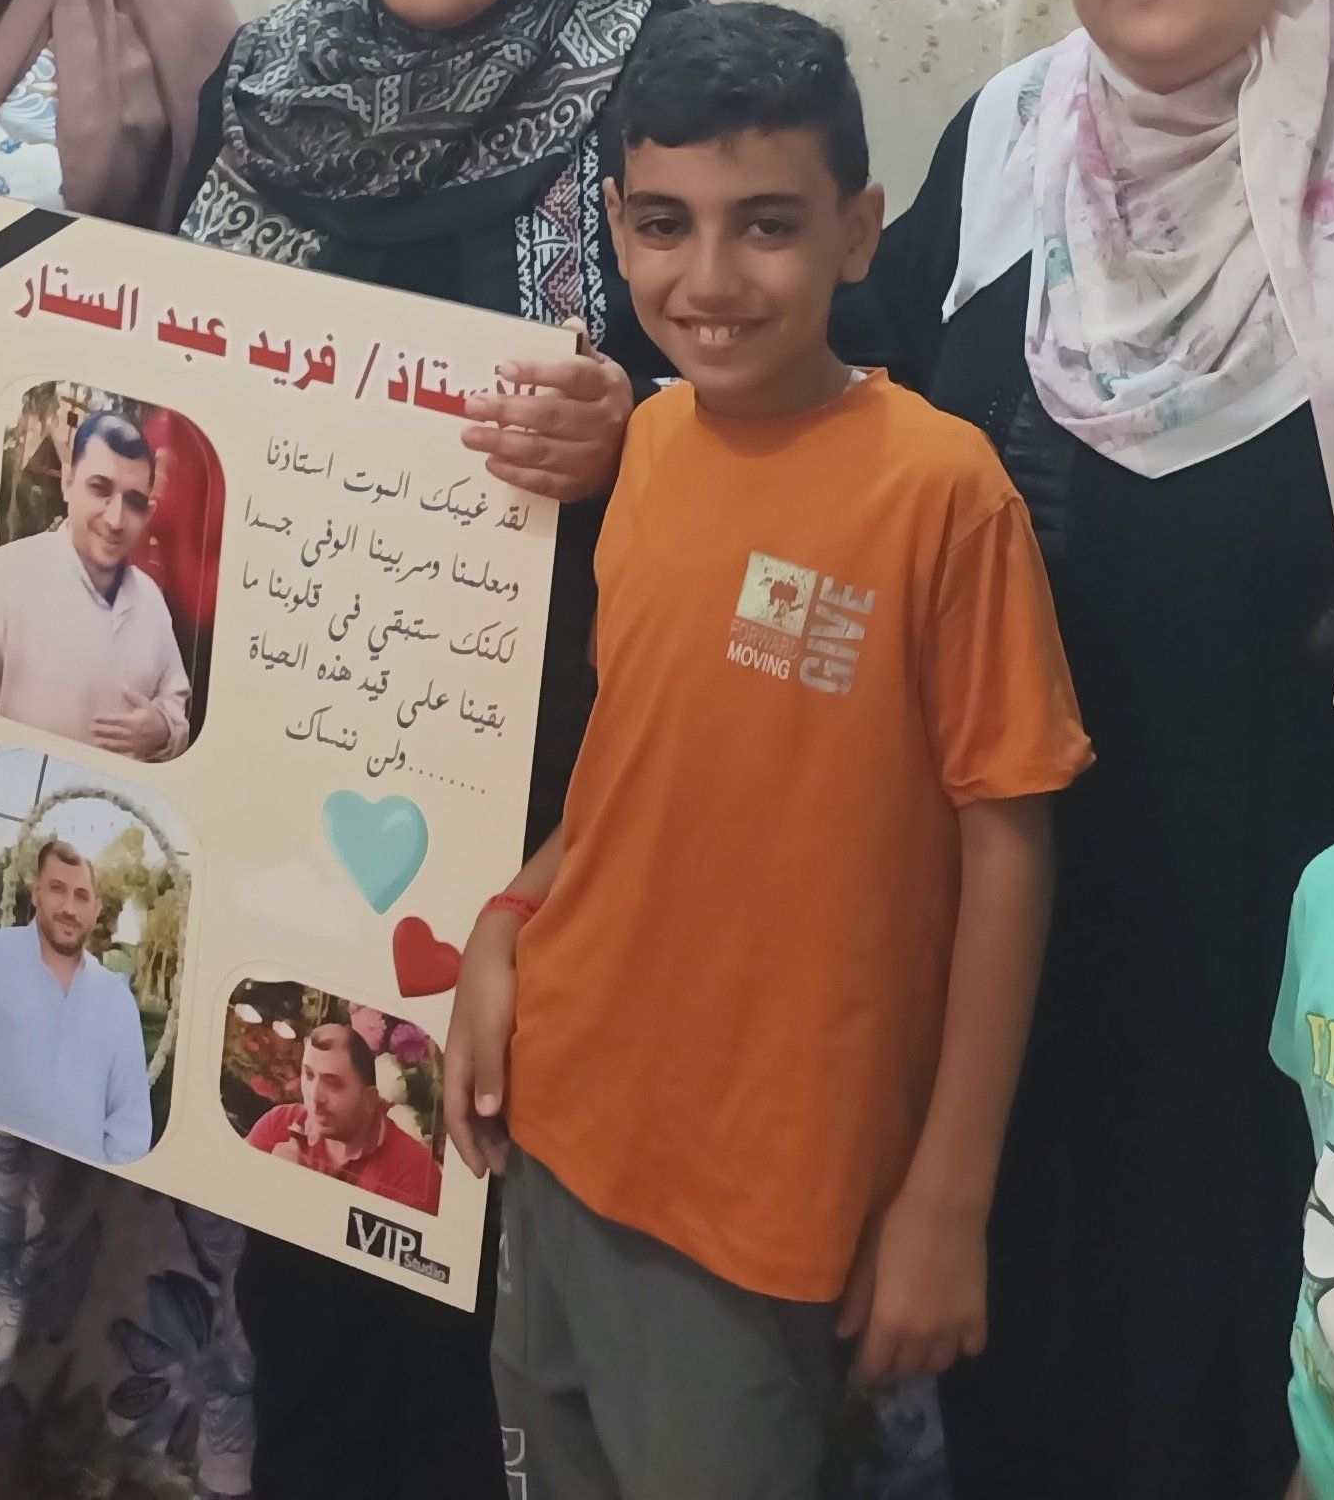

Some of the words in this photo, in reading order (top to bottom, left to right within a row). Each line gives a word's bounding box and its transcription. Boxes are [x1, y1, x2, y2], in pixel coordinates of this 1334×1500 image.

[14, 263, 139, 332] الستار
[157, 306, 227, 362] عبد
[249, 330, 336, 390] فريد
[388, 352, 536, 422] ستاذ
[267, 435, 335, 479] استاذنا
[343, 471, 411, 504] الموت
[420, 476, 489, 526] غيبك
[244, 495, 293, 536] جدا
[495, 504, 530, 531] لقد
[242, 560, 259, 590] ما
[369, 528, 440, 583] ومربينا
[452, 553, 519, 602] ومعلمنا
[268, 568, 322, 613] قلوبنا
[249, 631, 309, 670] الحياة
[368, 610, 441, 661] ستبقي
[449, 621, 519, 663] لكنك
[316, 655, 352, 681] هذه
[726, 640, 791, 680] MOVING
[357, 670, 391, 701] قيد
[396, 679, 450, 729] على
[285, 705, 358, 751] ننساك
[459, 690, 506, 738] بقينا
[352, 1212, 417, 1266] VIP
[403, 1253, 447, 1283] Studio
